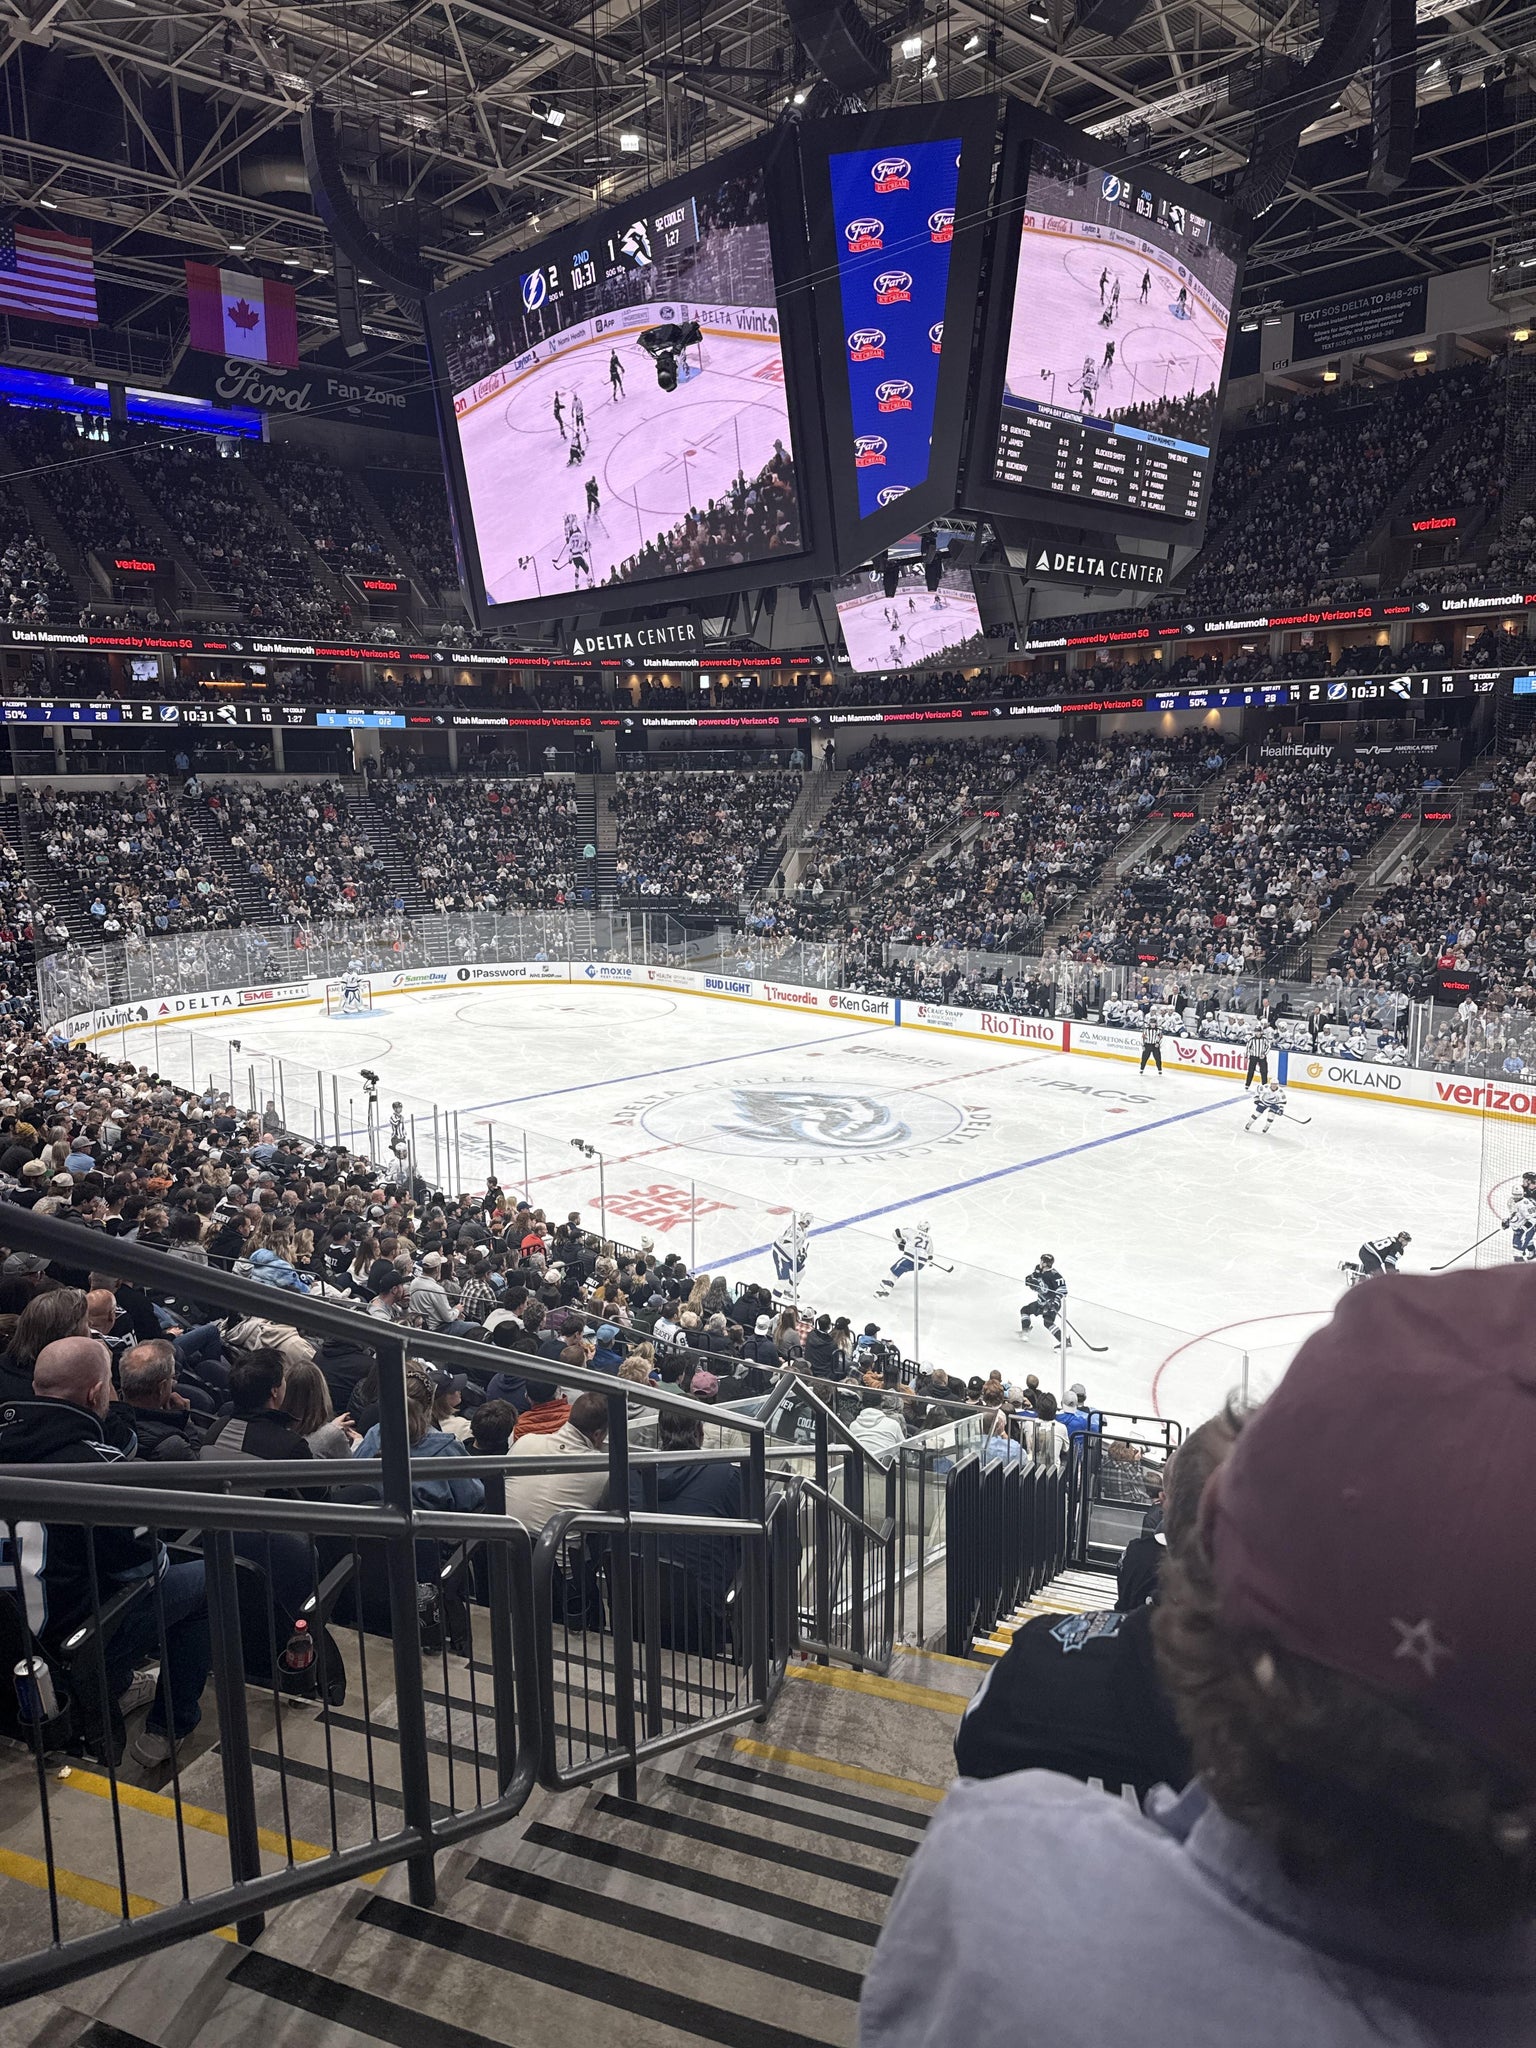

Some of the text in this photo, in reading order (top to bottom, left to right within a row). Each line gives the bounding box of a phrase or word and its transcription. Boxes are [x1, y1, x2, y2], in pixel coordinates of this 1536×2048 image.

[877, 161, 906, 182] Farr
[888, 180, 909, 190] CREAM
[1122, 182, 1130, 199] 2
[1140, 189, 1152, 201] 2ND
[1136, 197, 1153, 219] 10:31
[1162, 200, 1167, 216] 1
[664, 207, 686, 229] COOLEY
[665, 229, 680, 248] 1:27
[851, 222, 880, 242] Farr
[607, 239, 615, 262] 1
[861, 240, 881, 250] CREAM
[572, 249, 590, 267] 2ND
[548, 265, 559, 288] 2
[570, 261, 597, 291] 10:31
[879, 274, 908, 294] Farr
[889, 293, 910, 303] CREAM
[1299, 285, 1423, 323] TEXT SOS DELTA TO 848-261
[702, 311, 732, 325] DELTA
[570, 329, 586, 341] Health
[853, 332, 882, 350] Farr
[514, 353, 532, 370] Layton
[1273, 360, 1288, 369] GG
[215, 357, 312, 413] Ford
[881, 384, 910, 402] Farr
[327, 378, 407, 409] Fan Zone
[855, 439, 884, 457] Farr
[1008, 438, 1024, 447] JAMES
[1412, 517, 1456, 531] verizon
[115, 559, 156, 571] verizon
[1054, 553, 1164, 584] DELTA CENTER
[363, 579, 397, 591] verizon
[1383, 605, 1410, 614] verizon
[1442, 594, 1523, 610] Utah Mammoth
[1205, 607, 1372, 631] Utah Mammoth powered by Verizon 5G
[586, 624, 696, 653] DELTA CENTER
[1031, 637, 1067, 648] Mammoth
[1067, 634, 1099, 646] powered
[1099, 633, 1109, 644] by
[1109, 631, 1136, 641] Verizon
[1137, 629, 1149, 639] 5G
[1158, 626, 1180, 635] verizon
[12, 631, 193, 649] Utah Mammoth powered by Verizon 5G
[203, 641, 227, 650] verizon
[253, 643, 400, 659] Utah Mammoth powered by Verizon 5G
[1478, 672, 1501, 680] COOLEY
[1309, 685, 1320, 700] 2
[1351, 685, 1385, 698] 10:31
[1421, 678, 1428, 695] 1
[1441, 682, 1454, 693] 10
[1474, 682, 1494, 692] 1:27
[4, 710, 27, 719] 50%
[141, 706, 153, 720] 2
[1010, 698, 1143, 715] Utah Mammoth powered by Verizon 5G
[95, 711, 108, 720] 28
[121, 710, 133, 720] 14
[182, 710, 215, 722] 10:31
[245, 708, 251, 722] 1
[262, 713, 272, 722] 10
[287, 715, 303, 723] 1:27
[1260, 745, 1332, 758] HealthEquity
[404, 973, 447, 983] SameDay
[472, 967, 527, 979] 1Password
[600, 966, 632, 976] moxie
[705, 978, 724, 990] BUD
[725, 981, 751, 994] LIGHT
[1442, 982, 1470, 990] verizon
[244, 987, 306, 1002] SME STEEL
[772, 987, 818, 1006] Trucordia
[175, 995, 232, 1012] DELTA
[839, 998, 889, 1015] Ken Garff
[981, 1013, 1054, 1040] Rio Tinto
[1328, 1066, 1402, 1090] OKLAND
[1039, 1080, 1157, 1105] PACS
[614, 1090, 684, 1118] DELTA
[783, 1113, 992, 1166] DELTA CENTER
[629, 1184, 739, 1216] SEAT
[589, 1194, 702, 1232] GEEK
[914, 1236, 929, 1250] 21
[797, 1417, 816, 1430] COOL
